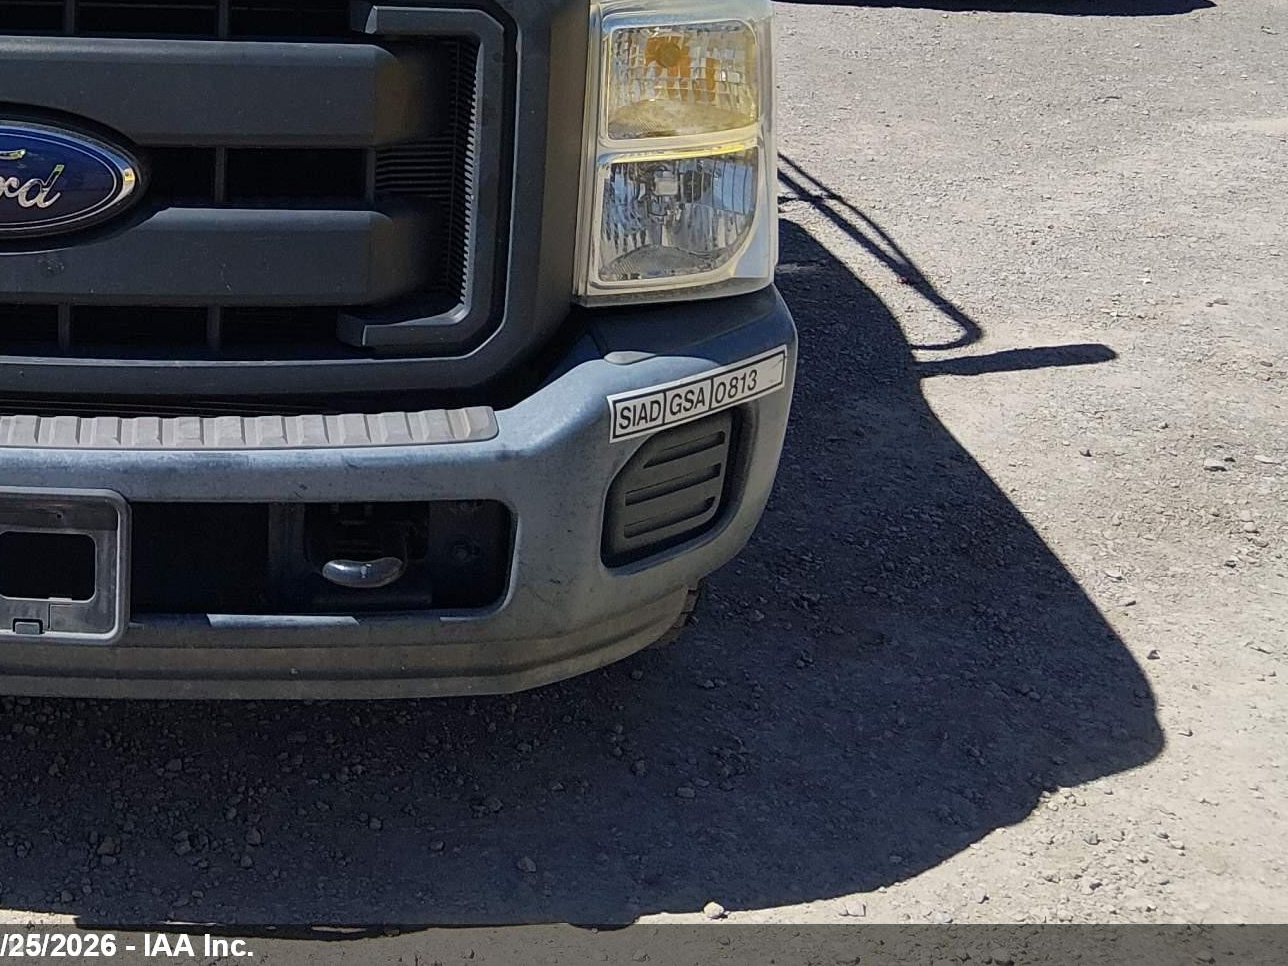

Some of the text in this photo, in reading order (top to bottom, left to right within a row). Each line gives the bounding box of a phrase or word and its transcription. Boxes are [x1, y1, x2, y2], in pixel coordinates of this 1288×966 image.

[618, 369, 758, 430] SIAD GSA 0813
